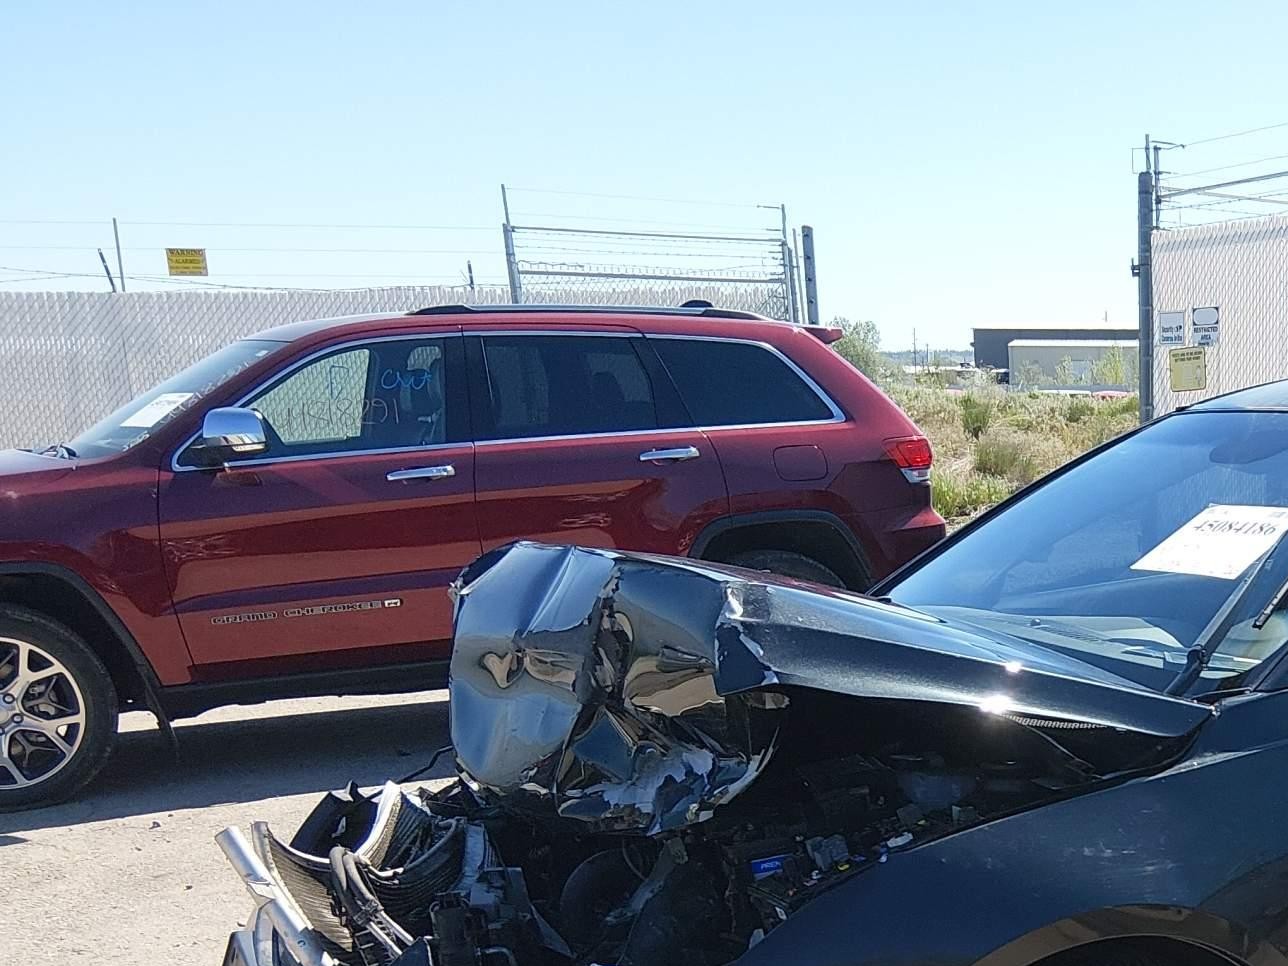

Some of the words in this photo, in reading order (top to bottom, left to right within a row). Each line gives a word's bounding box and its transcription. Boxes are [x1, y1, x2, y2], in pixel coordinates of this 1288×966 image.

[1193, 519, 1278, 536] 45084186
[211, 611, 278, 625] GRAND
[283, 600, 383, 617] CHEROKEE
